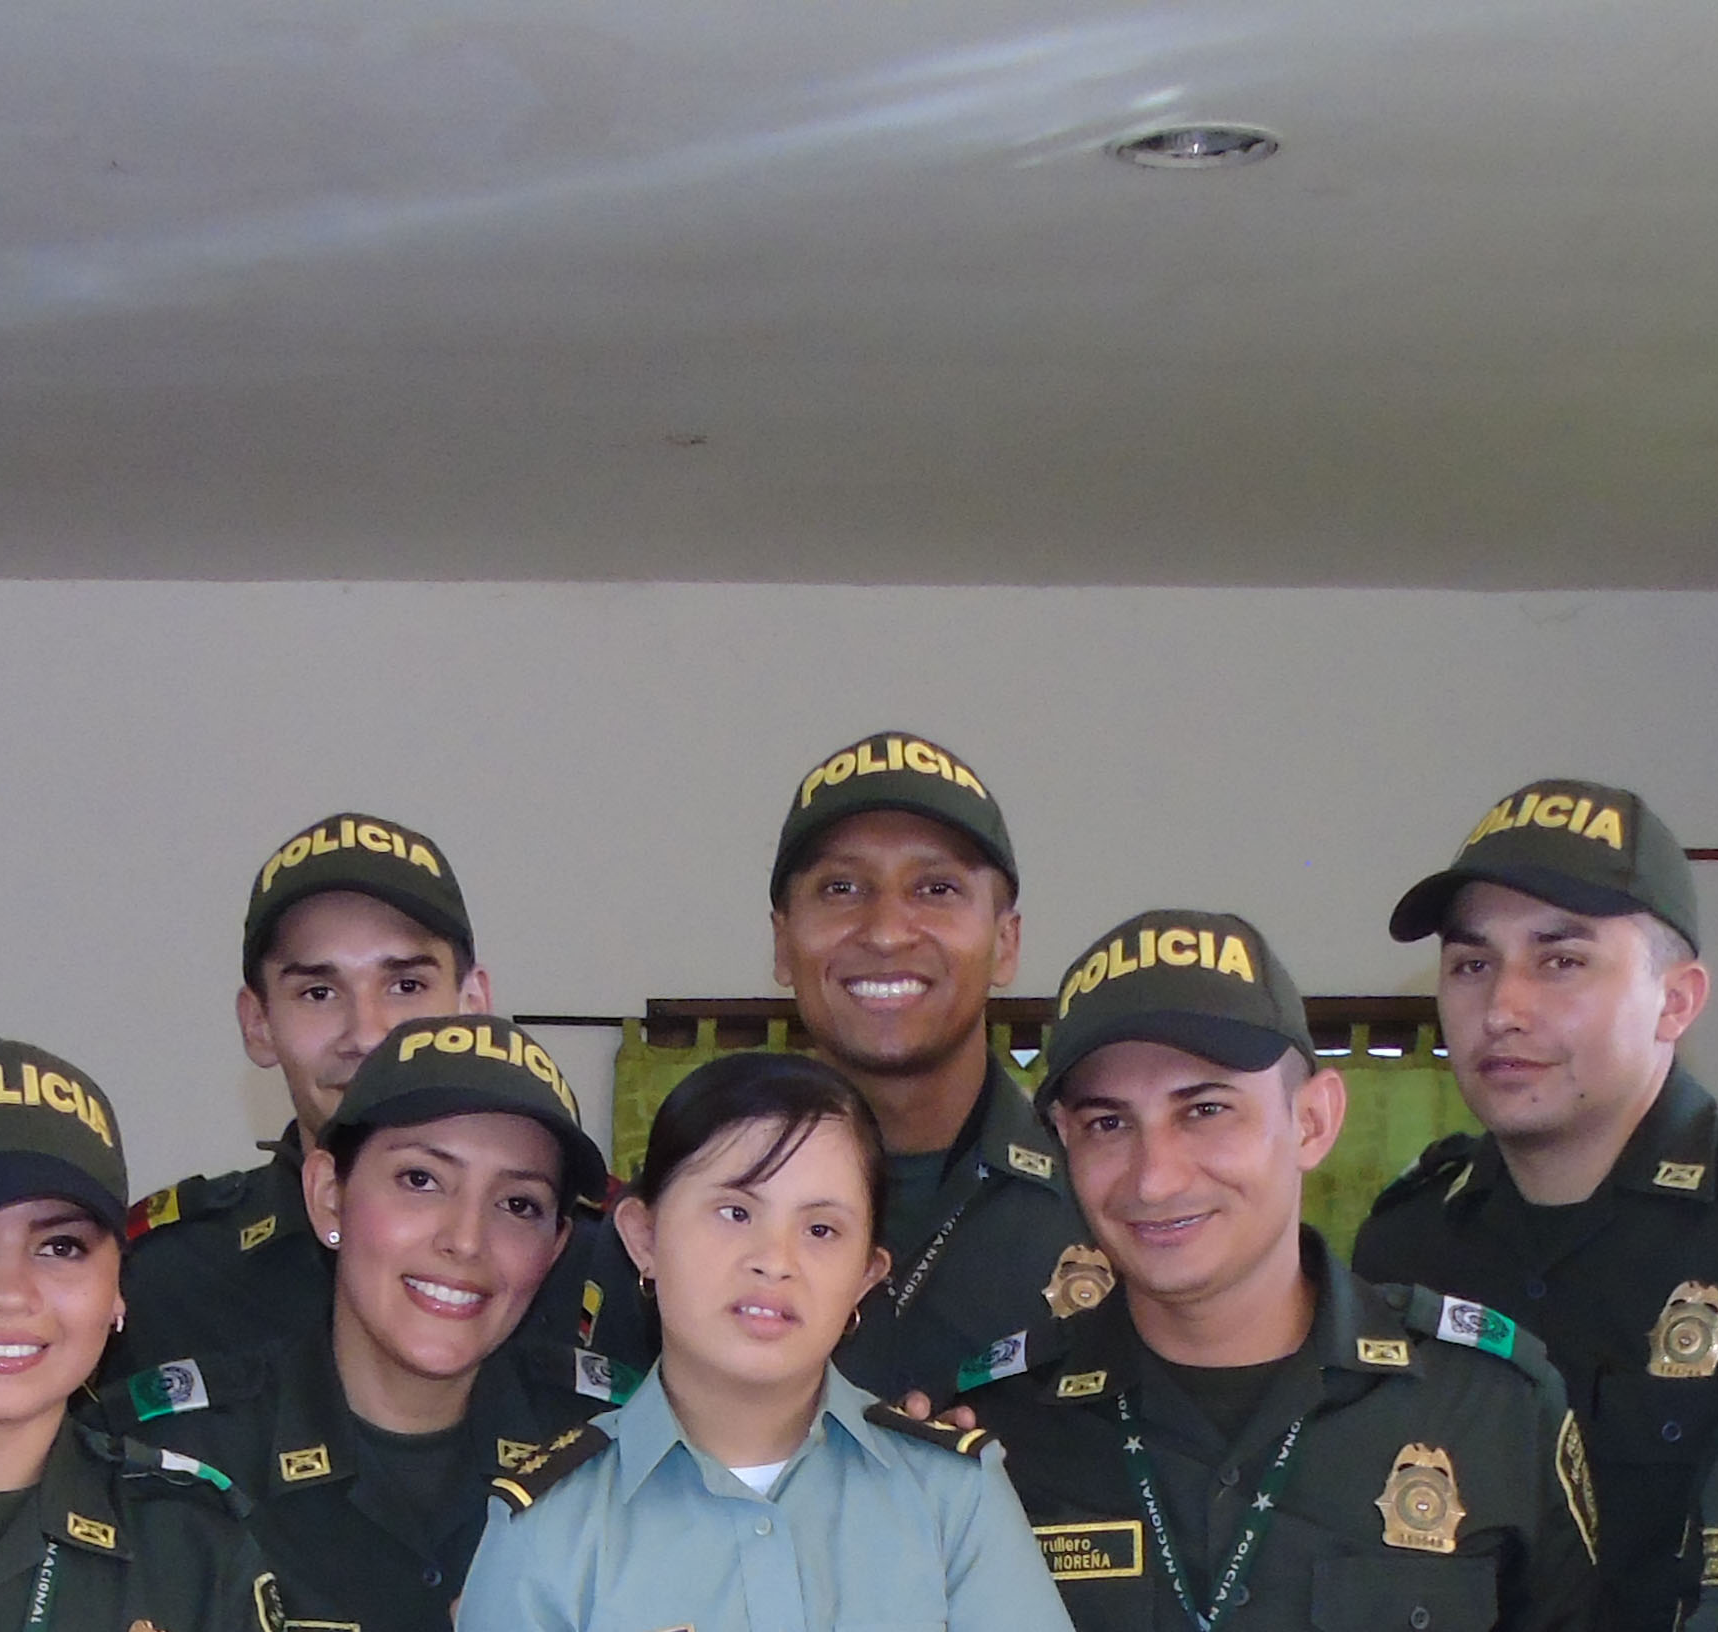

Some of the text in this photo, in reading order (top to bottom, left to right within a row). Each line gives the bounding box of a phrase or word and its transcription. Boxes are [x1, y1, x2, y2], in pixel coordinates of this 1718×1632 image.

[800, 738, 987, 808] POLICIA
[262, 820, 441, 893] POLICIA
[1455, 793, 1623, 860] OLICIA
[1059, 929, 1255, 1020] POLICIA
[1215, 1529, 1255, 1601] POLICIA
